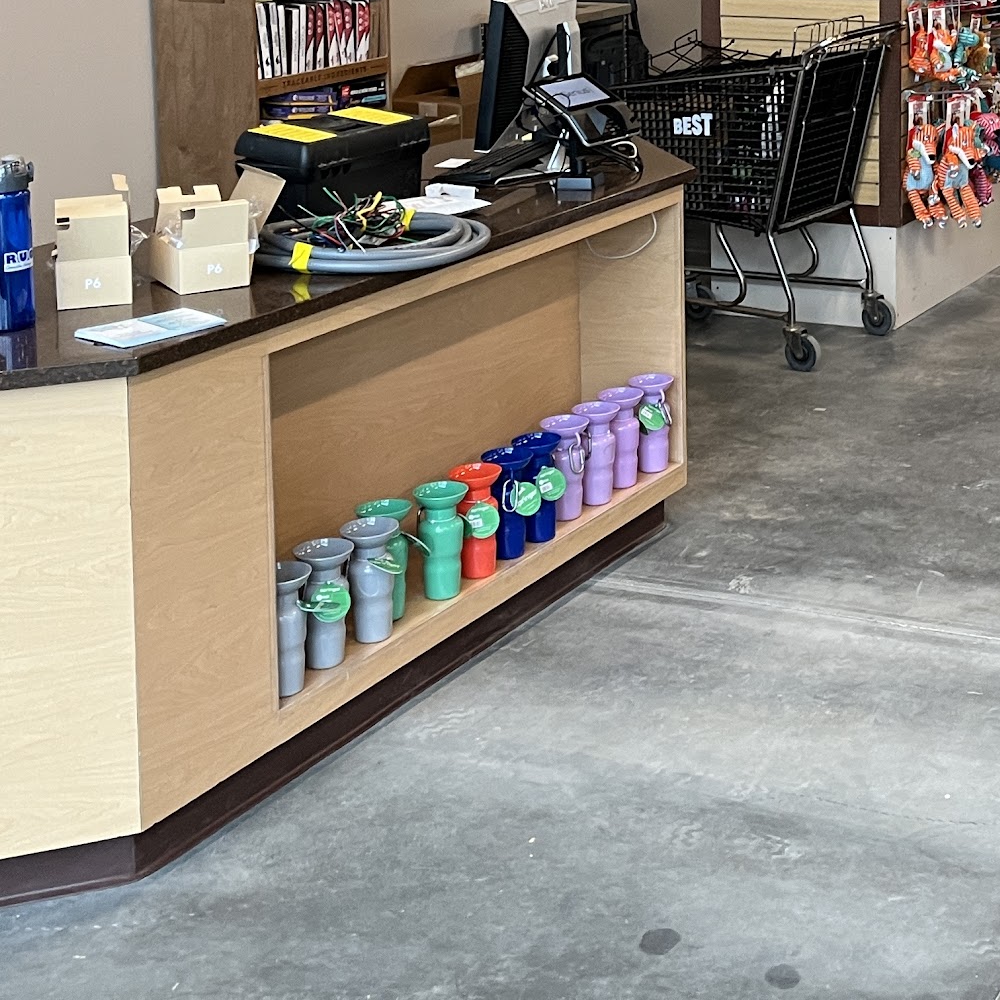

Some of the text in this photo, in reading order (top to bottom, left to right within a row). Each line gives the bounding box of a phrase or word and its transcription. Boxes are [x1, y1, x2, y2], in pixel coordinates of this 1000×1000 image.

[673, 112, 713, 136] BEST
[206, 264, 223, 275] P6
[84, 277, 101, 290] P6
